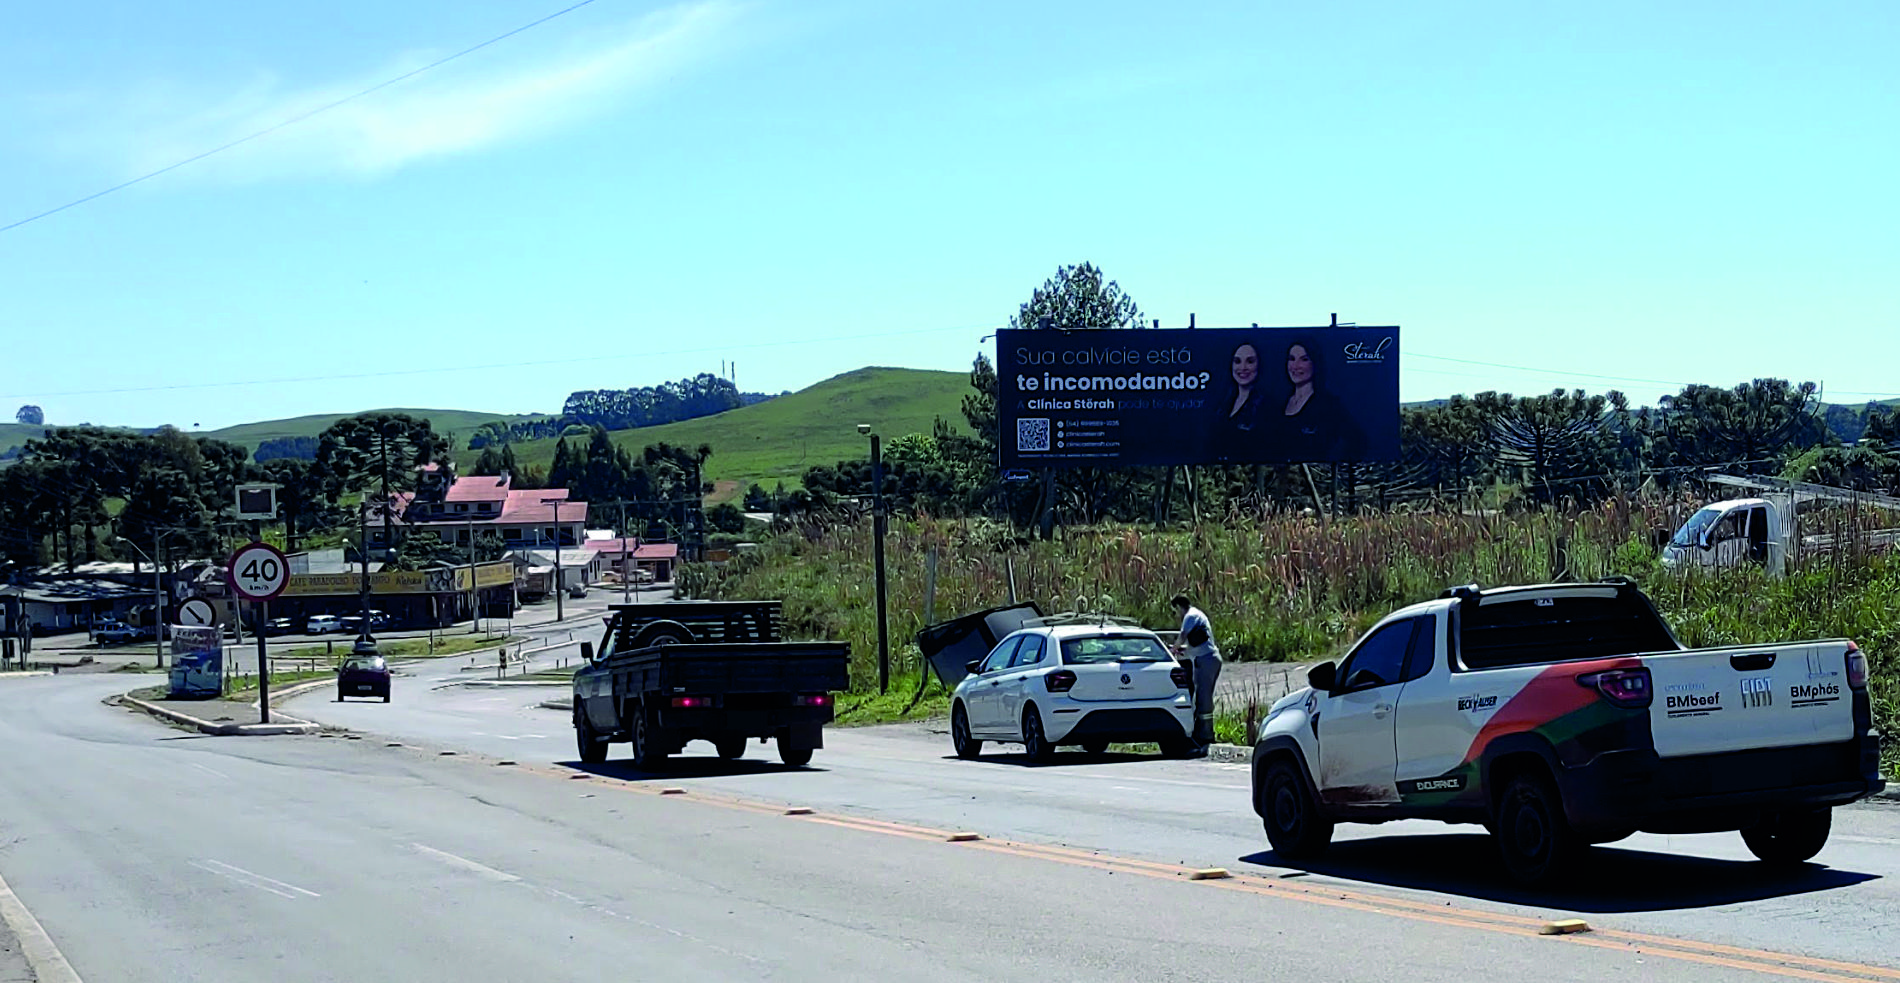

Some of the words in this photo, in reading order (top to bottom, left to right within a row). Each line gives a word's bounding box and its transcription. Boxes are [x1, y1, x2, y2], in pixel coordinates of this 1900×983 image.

[1016, 347, 1055, 365] Sua
[1062, 346, 1140, 365] calvície
[1147, 346, 1191, 364] está
[1016, 373, 1039, 391] te
[1043, 371, 1210, 391] incomodando?
[1027, 397, 1071, 410] Clínica
[241, 559, 278, 582] 40
[1666, 691, 1720, 708] BMbeef
[1740, 677, 1772, 708] FIAT
[1790, 682, 1840, 699] BMphós
[1416, 778, 1460, 791] ENDURANCE
